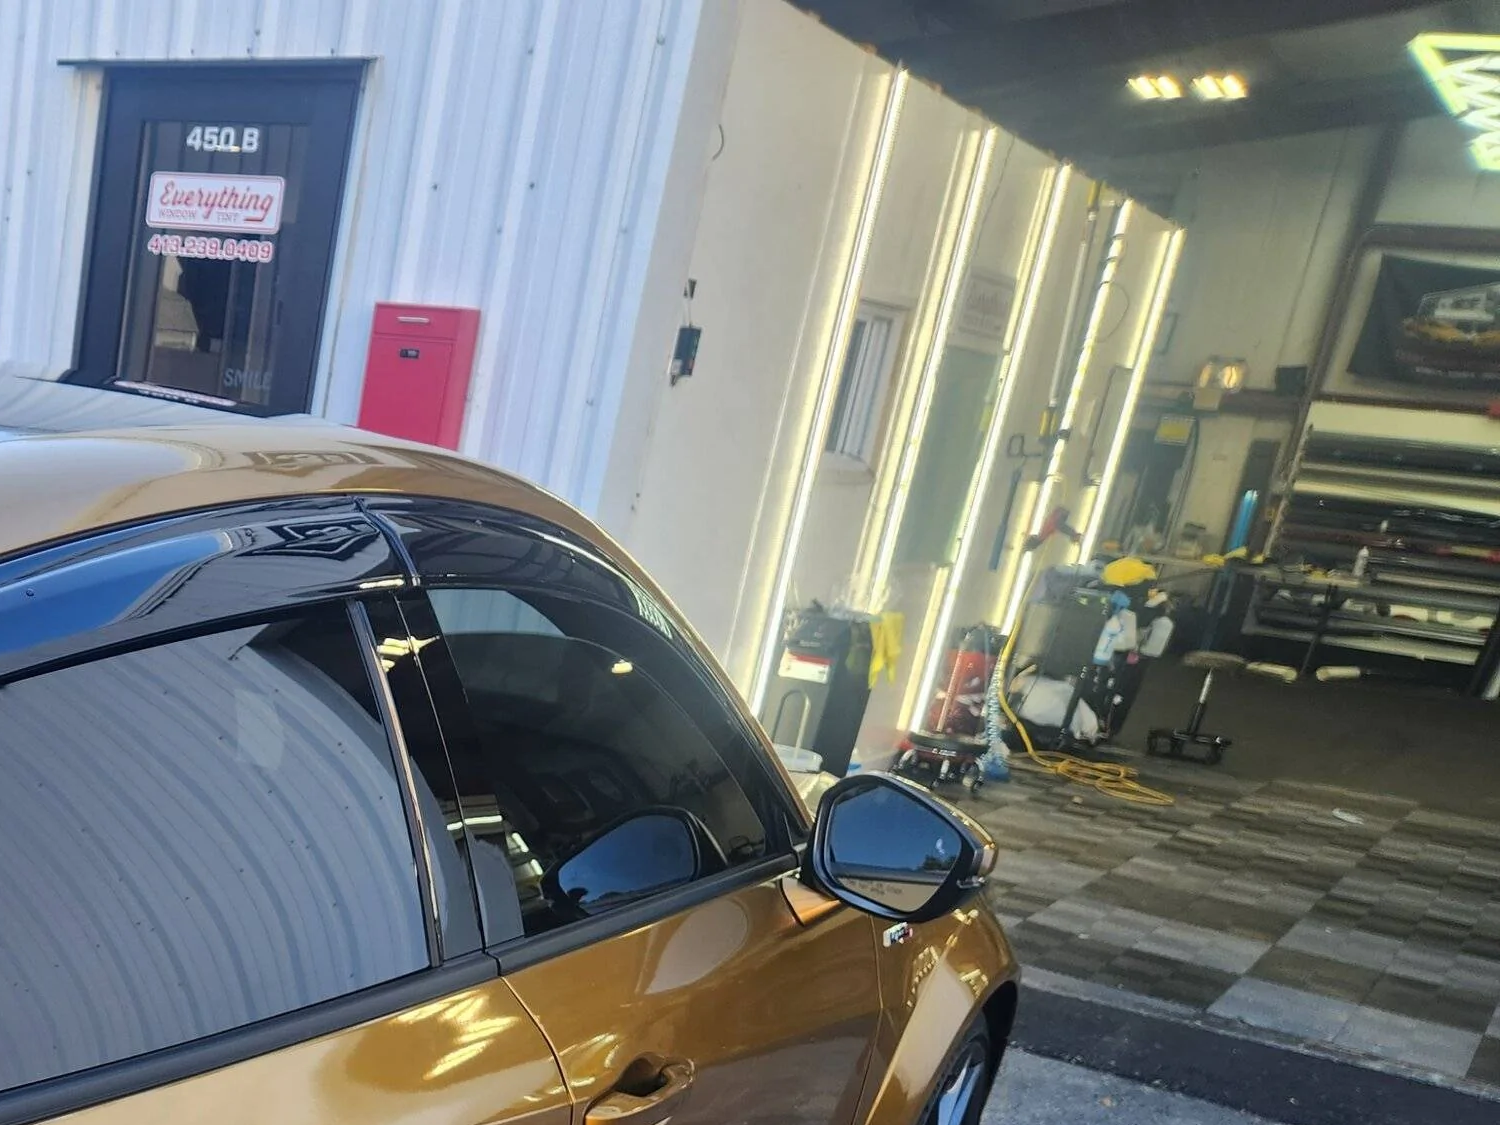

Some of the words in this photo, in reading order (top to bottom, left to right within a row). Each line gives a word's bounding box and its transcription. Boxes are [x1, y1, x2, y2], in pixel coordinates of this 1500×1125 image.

[186, 126, 235, 151] 450
[242, 127, 260, 152] B
[159, 180, 274, 222] Everything
[223, 367, 272, 390] SMILE
